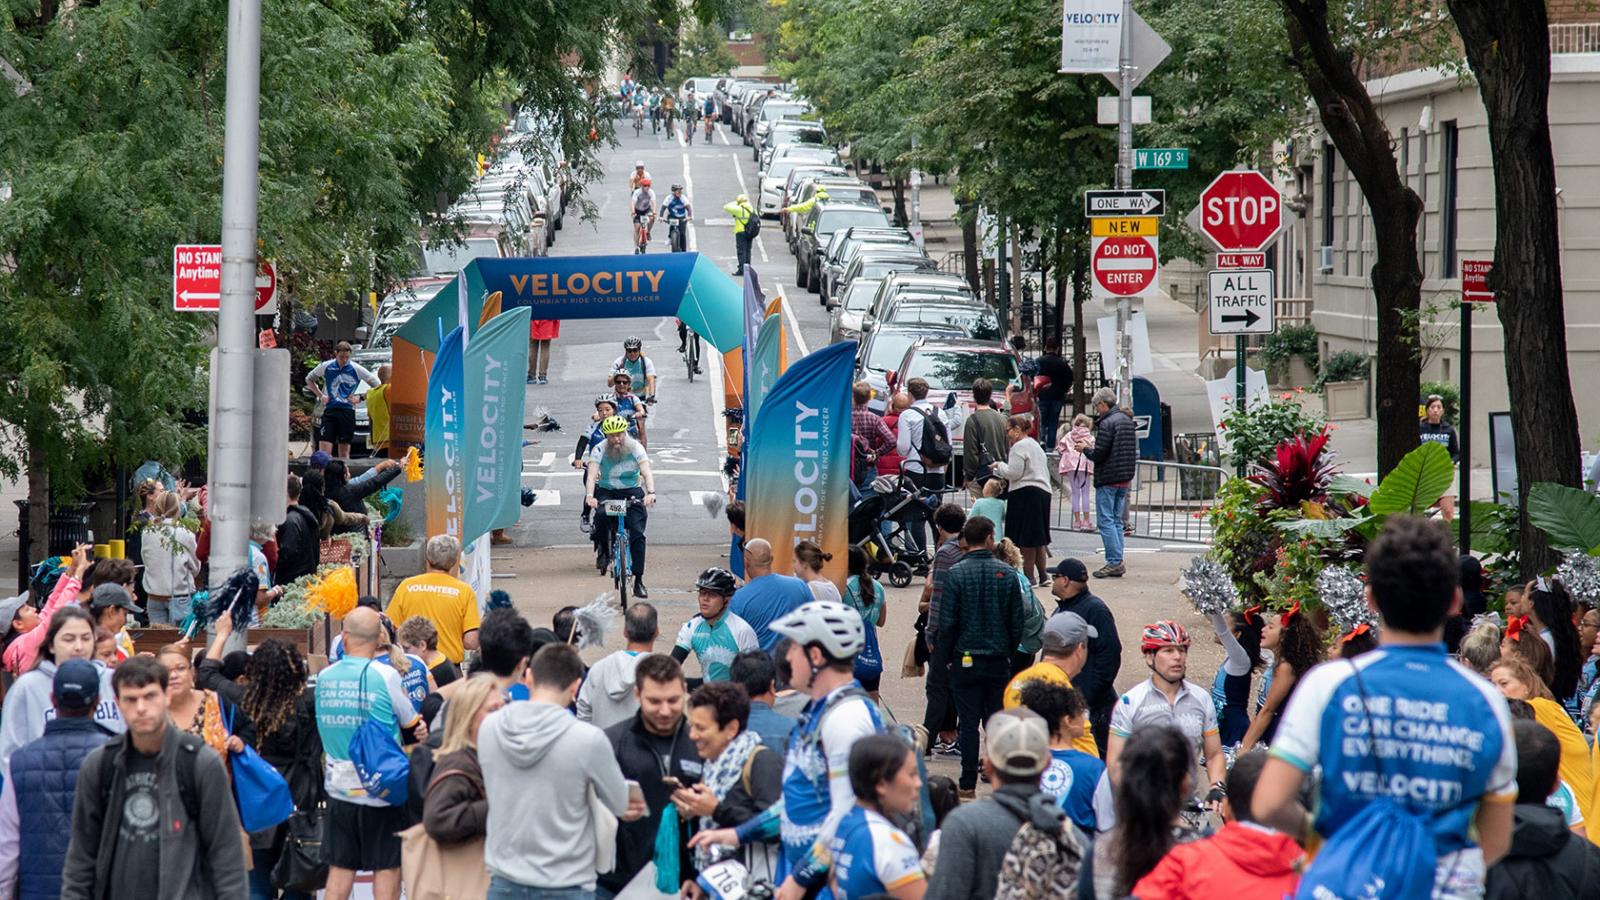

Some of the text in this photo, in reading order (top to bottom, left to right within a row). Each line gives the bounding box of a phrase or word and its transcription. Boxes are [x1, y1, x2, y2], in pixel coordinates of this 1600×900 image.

[1066, 13, 1120, 24] VELOCITY
[1138, 152, 1148, 166] W
[1153, 152, 1171, 167] 169
[1097, 199, 1153, 209] ONE WAY
[1207, 196, 1277, 226] STOP
[1109, 221, 1140, 233] NEW
[1104, 244, 1146, 255] DO NOT
[178, 252, 193, 264] NO
[1220, 256, 1262, 266] ALL WAY
[179, 266, 219, 281] Anytime
[1464, 264, 1473, 272] NO
[509, 270, 665, 296] VELOCITY
[1107, 273, 1143, 284] ENTER
[1224, 277, 1258, 291] ALL
[517, 298, 567, 306] COLUMBIA'S
[1215, 295, 1267, 307] TRAFFIC
[476, 354, 502, 503] VELOCITY
[441, 384, 457, 535] ELOCITY
[821, 450, 829, 469] END
[820, 473, 828, 485] TO
[407, 584, 460, 597] VOLUNTEER
[320, 681, 360, 689] ONE RIDE
[320, 690, 337, 698] CAN
[1343, 695, 1449, 722] ONE RIDE
[1343, 716, 1485, 752] CAN CHANGE
[712, 867, 738, 893] 716
